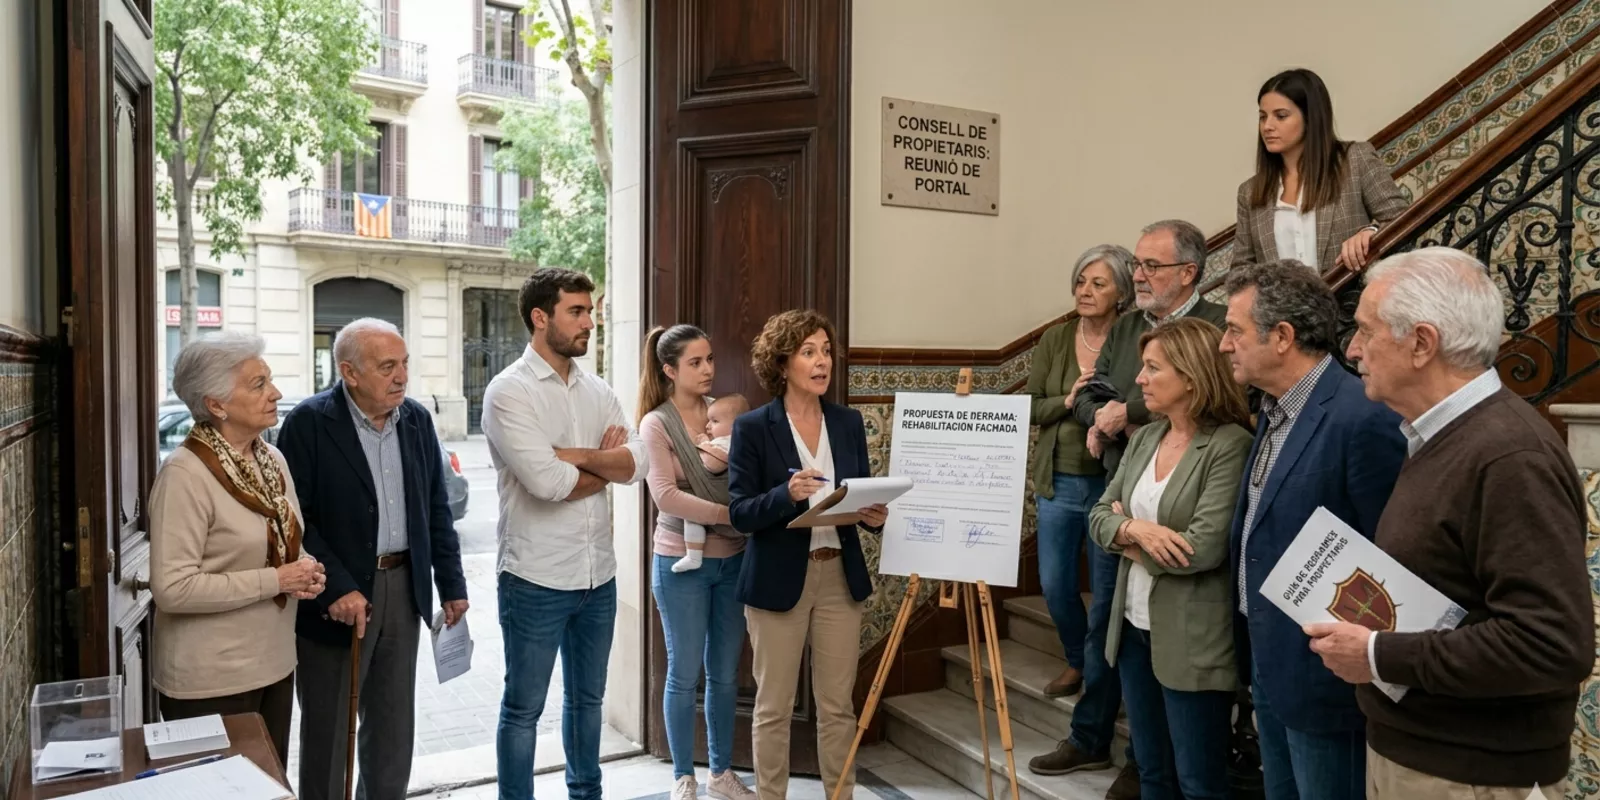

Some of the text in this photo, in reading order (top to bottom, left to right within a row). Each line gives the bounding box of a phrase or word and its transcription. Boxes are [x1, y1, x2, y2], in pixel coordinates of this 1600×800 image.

[898, 115, 987, 140] CONSELL DE
[893, 135, 990, 160] PROPIETARIS:
[904, 156, 980, 178] REUNIÓ DE
[915, 177, 970, 196] PORTAL
[903, 409, 954, 420] PROPUESTA
[956, 411, 968, 420] DE
[975, 423, 1018, 433] FACHADA
